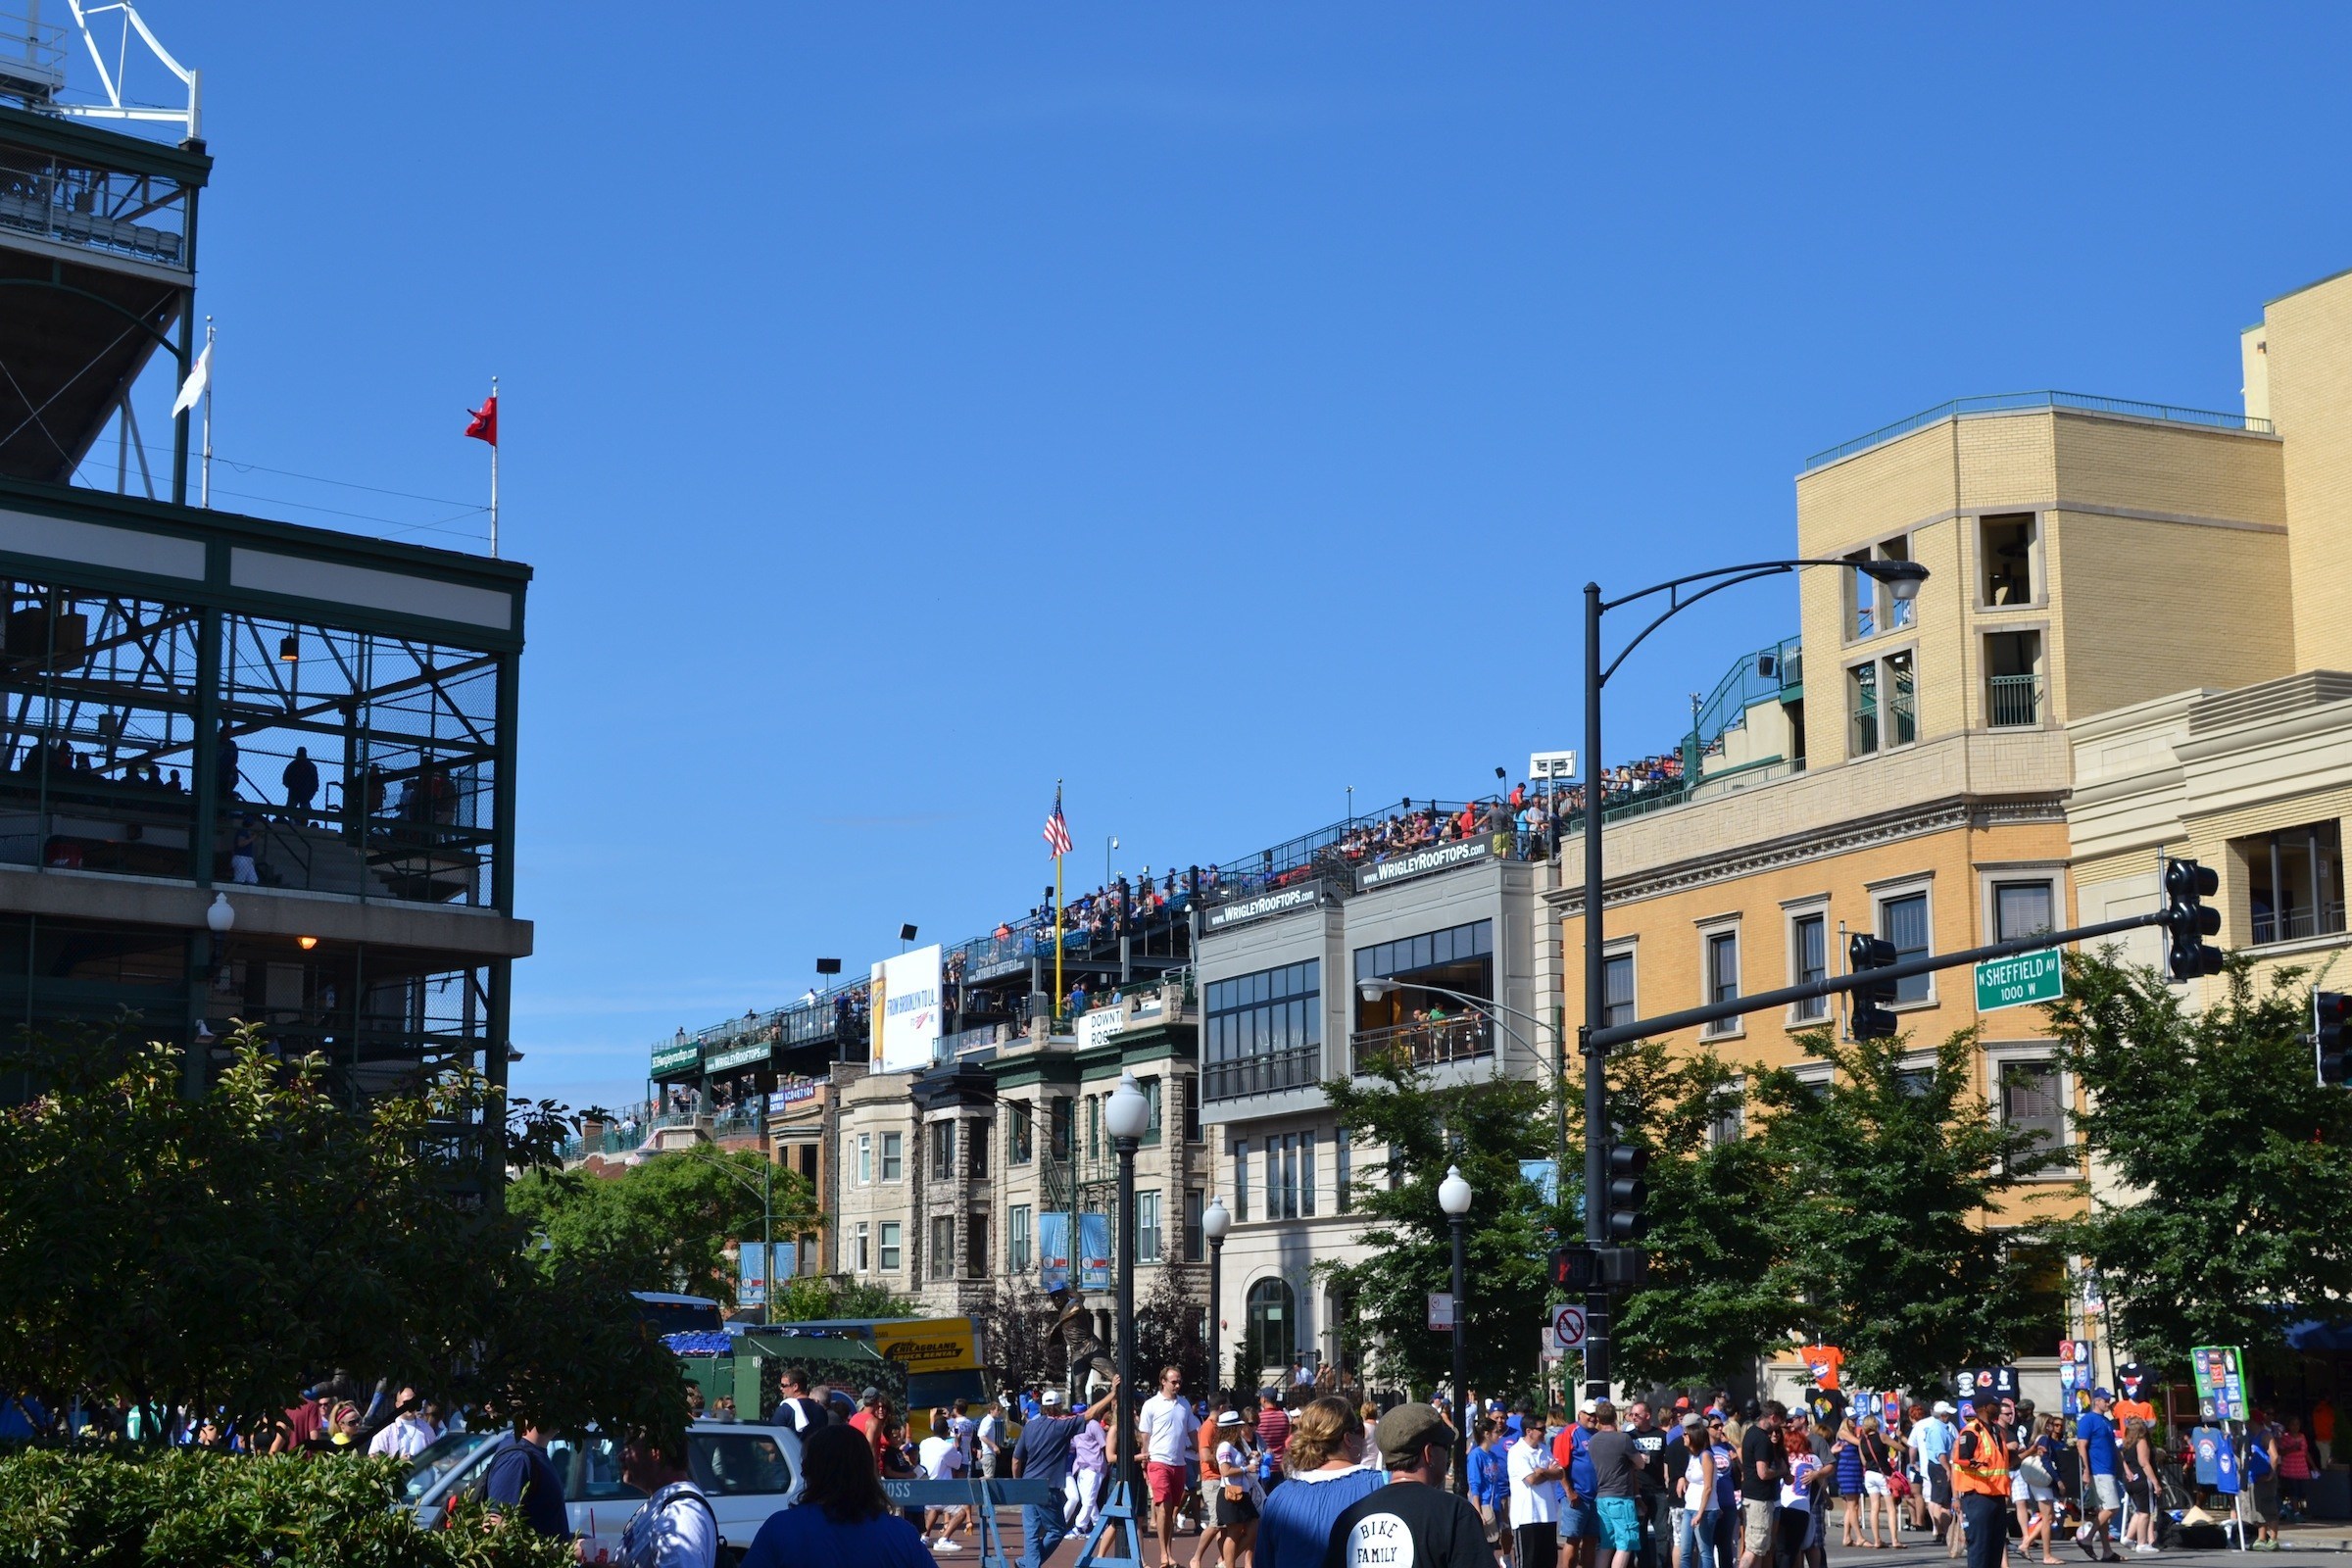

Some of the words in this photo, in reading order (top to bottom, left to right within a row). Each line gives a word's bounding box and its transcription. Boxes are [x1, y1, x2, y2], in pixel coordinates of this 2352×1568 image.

[1363, 843, 1486, 885] www.WRIGLEYROOFTOPS.com
[1211, 890, 1314, 925] www.WRIGLEYROOFTOPS.com
[1979, 973, 1985, 986] N
[1985, 958, 2043, 987] SHEFFIELD
[2045, 957, 2056, 972] AV
[899, 991, 921, 1013] BROOKLYN
[2001, 985, 2024, 1001] 1000
[2028, 982, 2036, 996] W
[894, 1342, 957, 1353] CHICAGOLAND
[1360, 1520, 1398, 1540] BIKE
[1357, 1546, 1397, 1564] FAMILY
